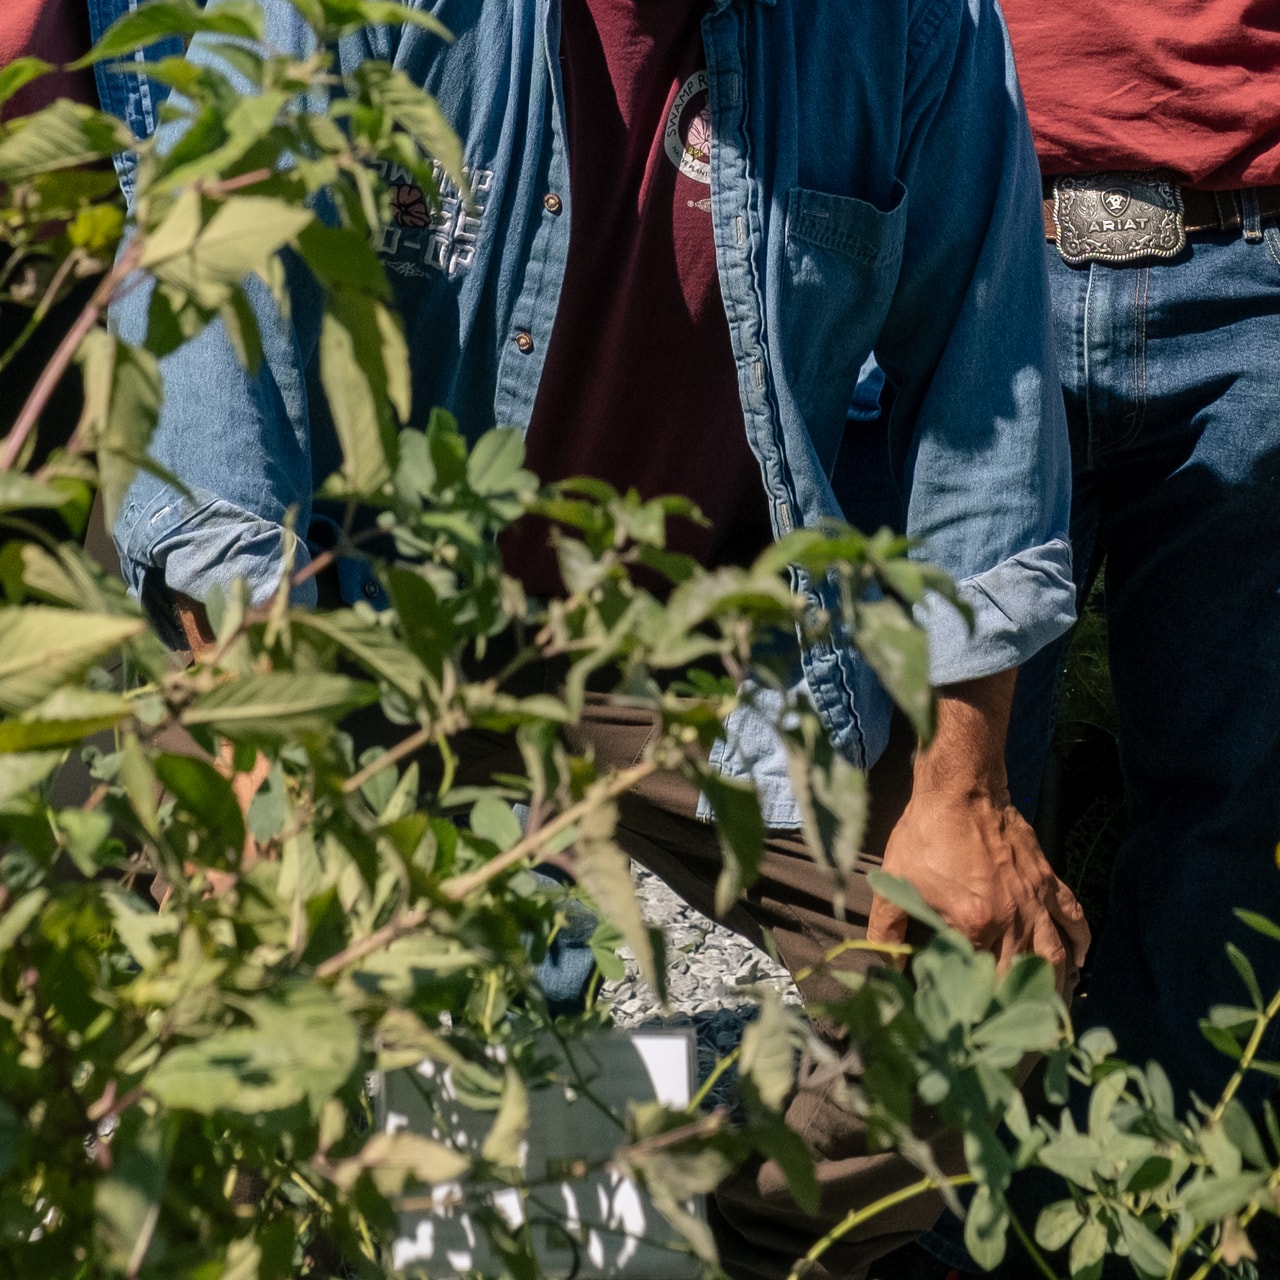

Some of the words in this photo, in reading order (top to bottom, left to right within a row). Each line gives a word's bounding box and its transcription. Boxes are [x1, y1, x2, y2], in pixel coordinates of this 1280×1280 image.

[667, 81, 694, 137] SWAMP
[688, 164, 711, 178] PLANT
[1088, 217, 1150, 233] ARIAT
